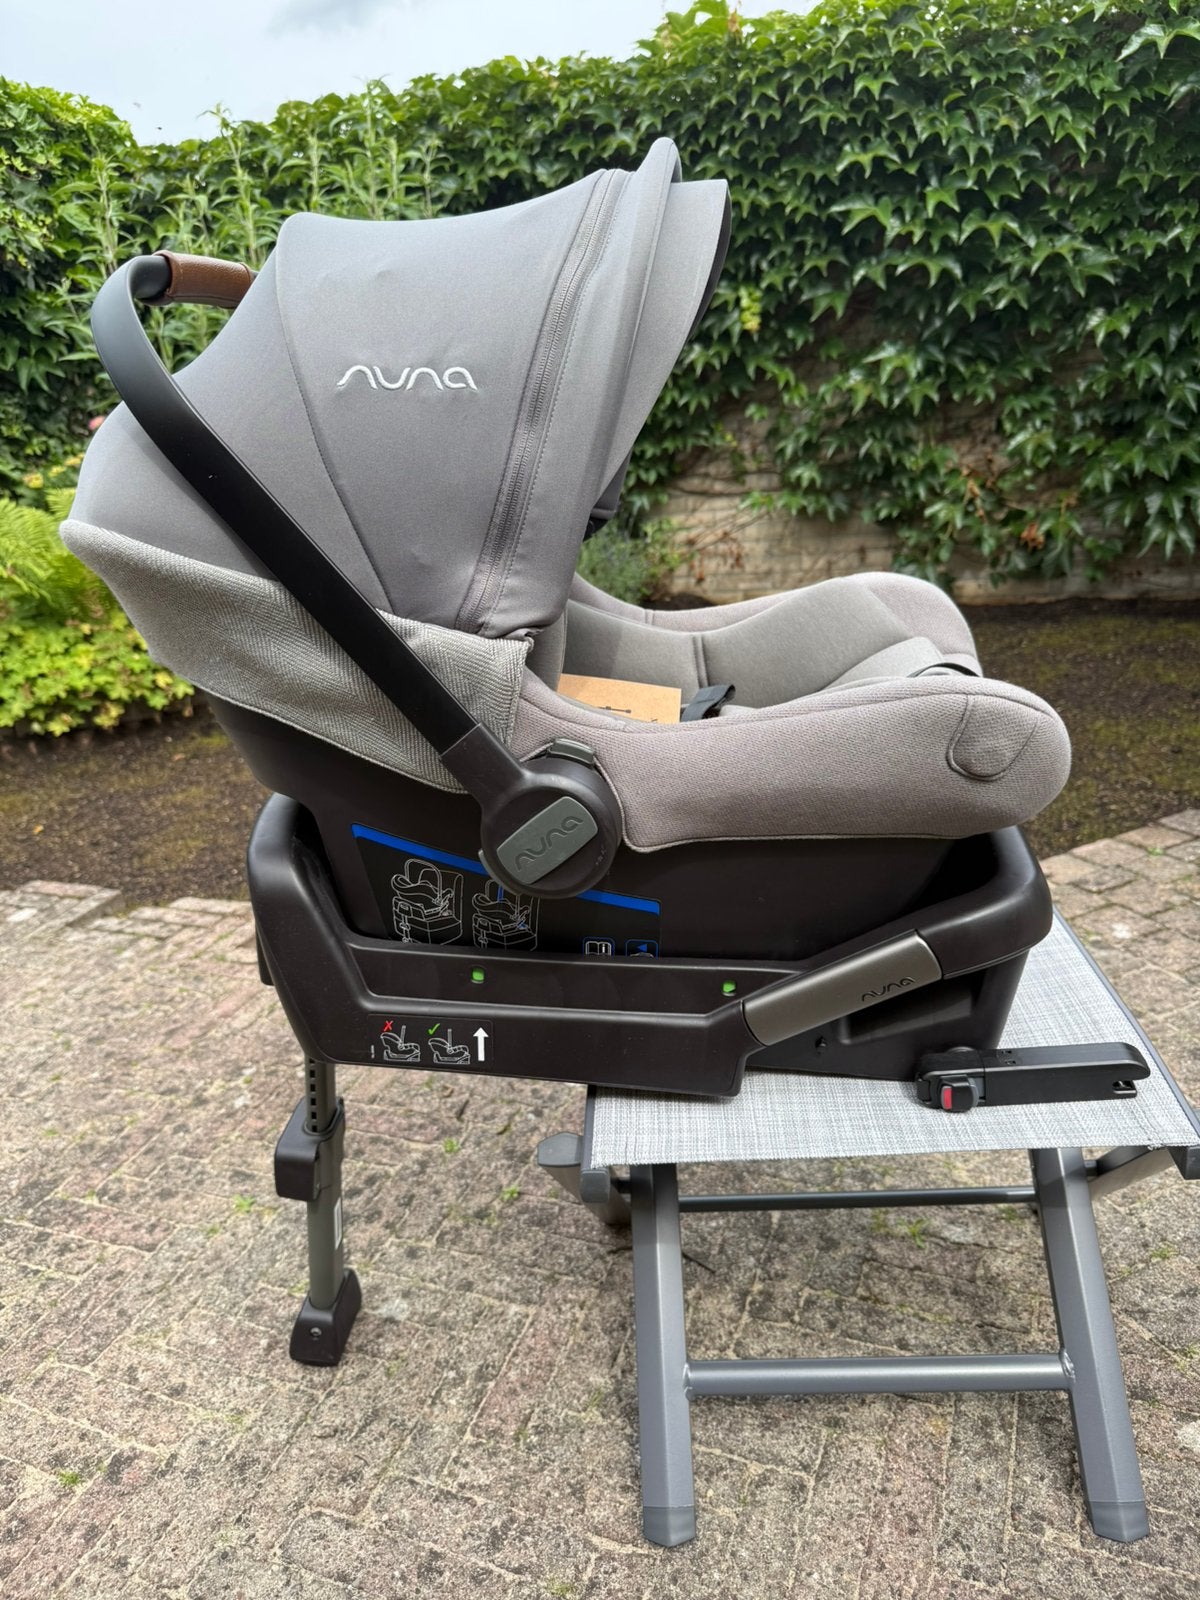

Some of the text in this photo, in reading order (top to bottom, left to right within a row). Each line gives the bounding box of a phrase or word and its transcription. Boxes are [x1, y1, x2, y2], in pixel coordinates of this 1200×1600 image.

[337, 365, 478, 391] nuna
[514, 815, 584, 872] nuna
[861, 976, 916, 1002] nuna
